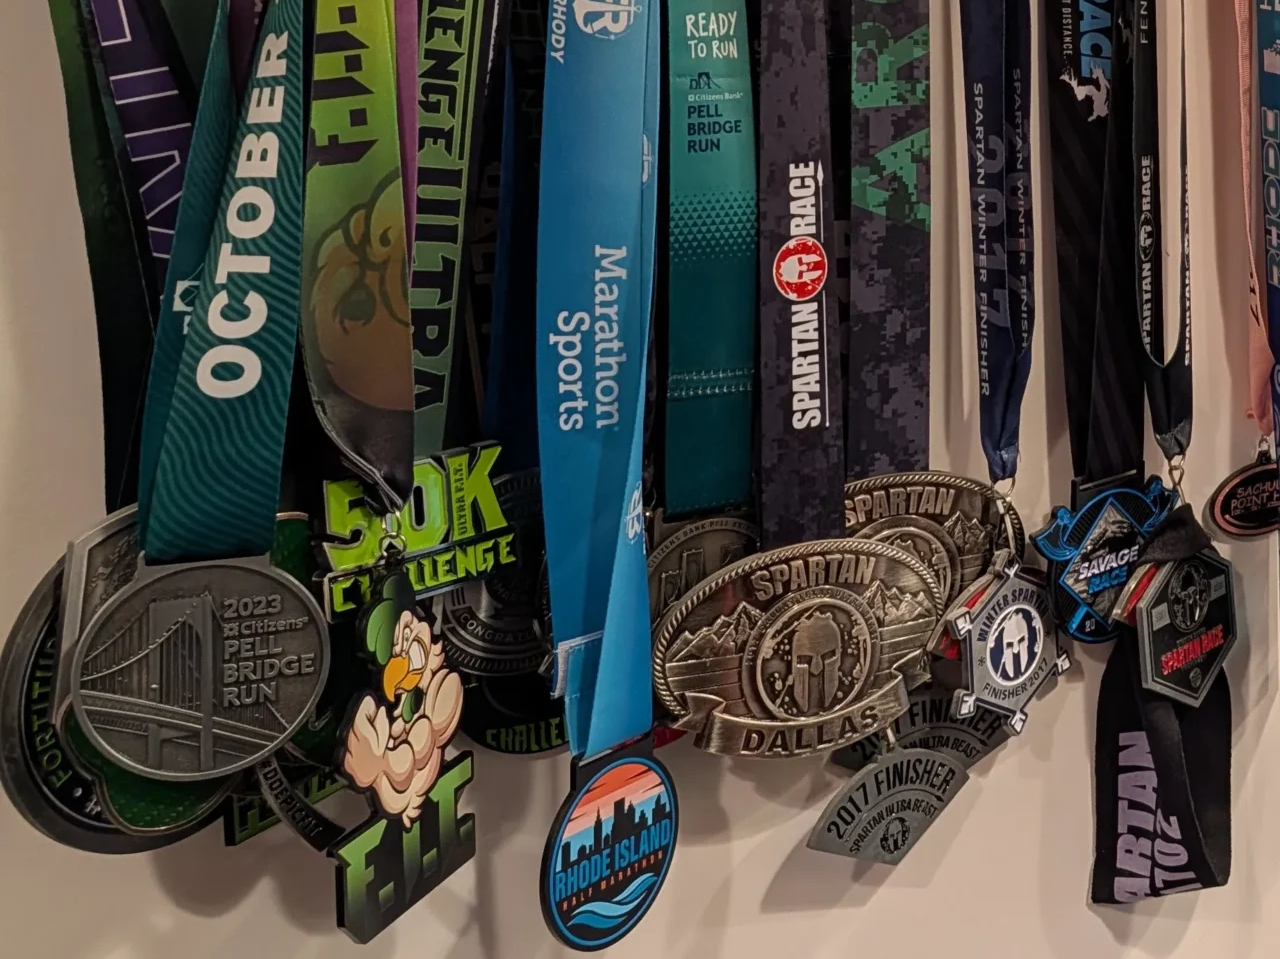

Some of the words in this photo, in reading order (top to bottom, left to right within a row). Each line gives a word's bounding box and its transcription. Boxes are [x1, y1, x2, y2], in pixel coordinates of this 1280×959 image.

[685, 10, 738, 39] READY
[687, 39, 707, 59] TO
[712, 38, 738, 59] RUN
[1061, 7, 1074, 60] DISTANCE.
[686, 104, 723, 119] PELL
[694, 93, 723, 102] Citizens
[1013, 67, 1024, 171] SPARTAN
[686, 119, 742, 137] BRIDGE
[686, 138, 721, 154] RUN
[973, 82, 986, 186] SPARTAN
[788, 160, 816, 236] RACE
[1140, 154, 1151, 211] RACE
[196, 30, 289, 399] OCTOBER
[976, 193, 988, 283] WINTER
[1015, 178, 1027, 266] WINTER
[412, 165, 464, 413] ULTRA
[594, 244, 628, 431] Marathon
[979, 292, 990, 397] FINISHER
[549, 310, 591, 432] Sports
[791, 301, 822, 430] SPARTAN
[322, 445, 509, 572] 50K
[456, 494, 469, 536] ULTRA
[845, 487, 956, 526] SPARTAN
[1230, 492, 1270, 510] POINT
[647, 535, 683, 569] CITIZENS
[682, 521, 707, 537] BANK
[709, 519, 731, 529] PELL
[1078, 544, 1141, 581] SAVAGE
[751, 554, 877, 601] SPARTAN
[1088, 566, 1129, 595] RACE
[223, 593, 282, 619] 2023
[241, 616, 305, 633] Citizens
[976, 594, 1011, 643] WINTER
[223, 636, 283, 659] PELL
[223, 654, 315, 684] BRIDGE
[1160, 641, 1203, 677] SPARTAN
[1200, 623, 1225, 654] RACE
[223, 682, 278, 708] RUN
[981, 682, 1029, 701] FINISHER
[1027, 657, 1049, 688] 2017
[740, 706, 880, 755] DALLAS
[950, 736, 981, 760] BEAST
[826, 781, 871, 841] 2017
[873, 757, 957, 796] FINISHER
[849, 811, 886, 855] SPARTAN
[911, 798, 938, 820] BEAST
[554, 855, 612, 904] RHODE
[613, 815, 673, 879] ISLAND
[562, 887, 595, 912] HALF
[600, 850, 665, 892] MARATHON
